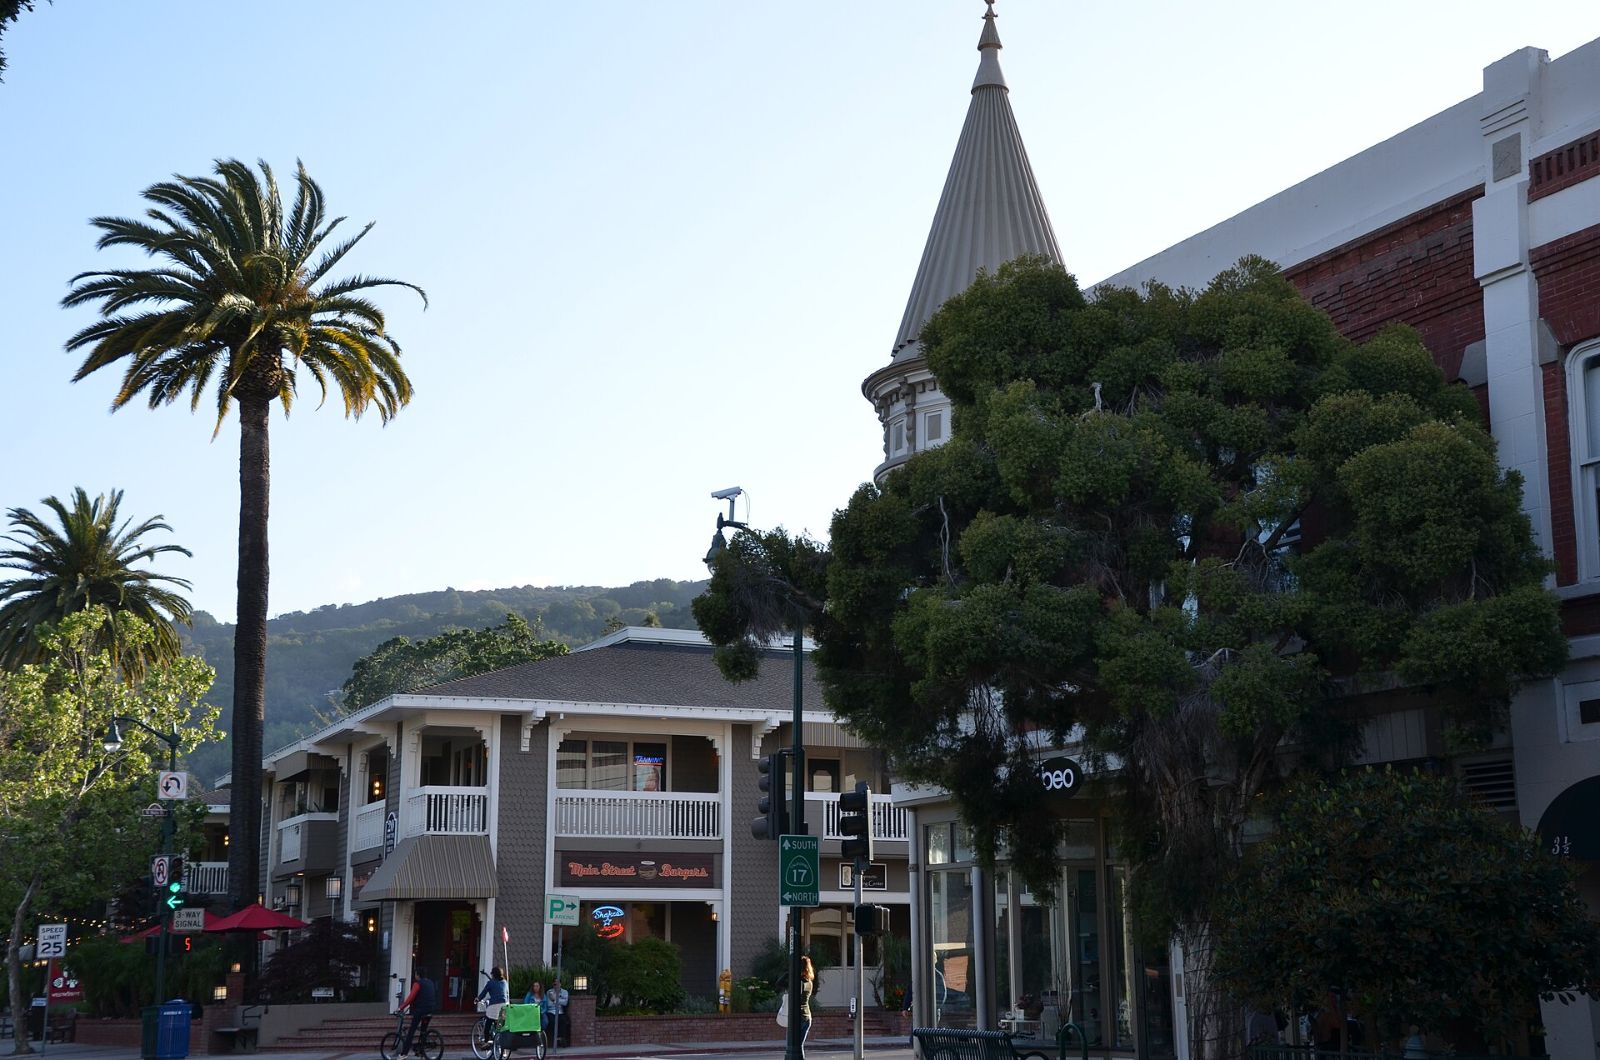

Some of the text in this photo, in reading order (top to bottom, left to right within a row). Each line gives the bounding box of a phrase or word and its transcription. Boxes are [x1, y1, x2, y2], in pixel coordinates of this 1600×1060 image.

[792, 840, 817, 850] SOUTH
[569, 862, 709, 880] Main Street Burgers
[793, 869, 807, 882] 17
[793, 892, 818, 902] NORTH
[176, 911, 201, 919] 3-WAY
[175, 920, 202, 928] SIGNAL
[41, 942, 63, 954] 25
